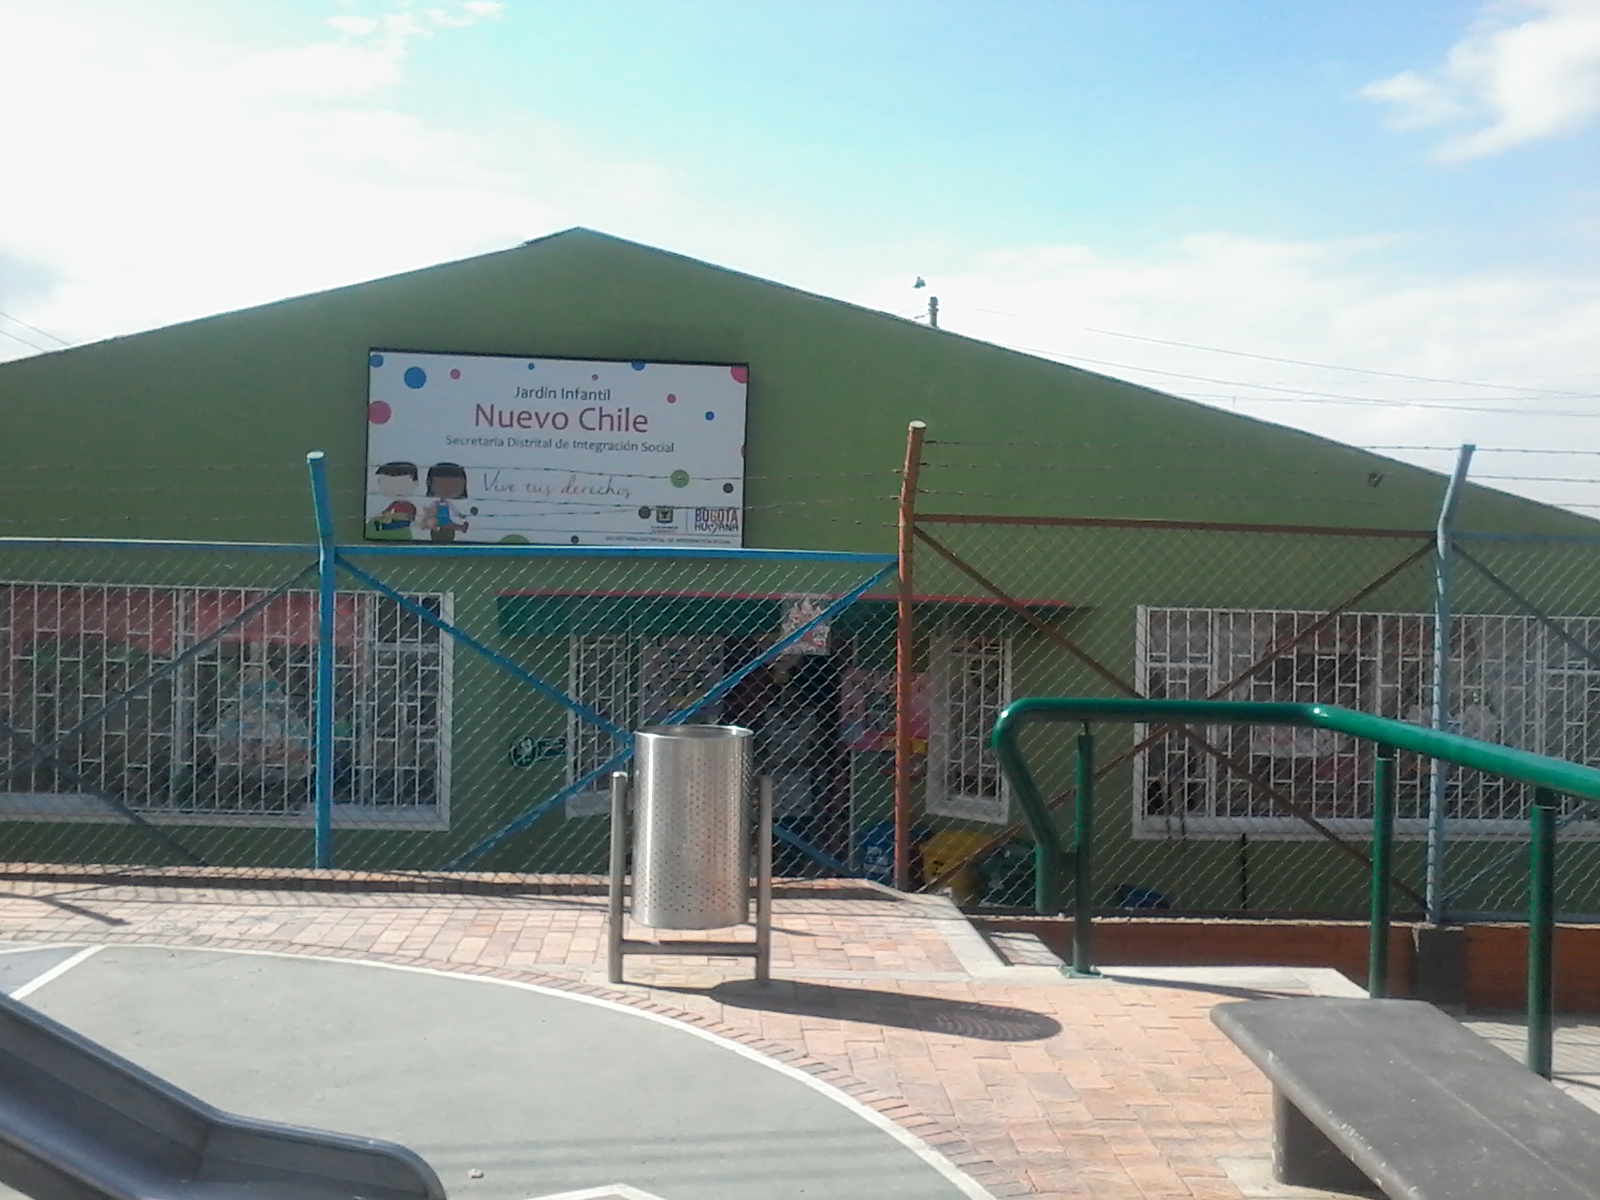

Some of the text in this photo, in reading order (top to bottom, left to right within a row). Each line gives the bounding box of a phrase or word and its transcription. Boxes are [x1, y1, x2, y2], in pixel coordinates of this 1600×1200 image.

[561, 387, 611, 401] Infantil
[475, 403, 648, 433] Nuevo Chile
[507, 437, 552, 449] Distrital
[555, 438, 570, 449] de
[641, 441, 675, 453] Social
[483, 470, 632, 499] Vive tus derechos
